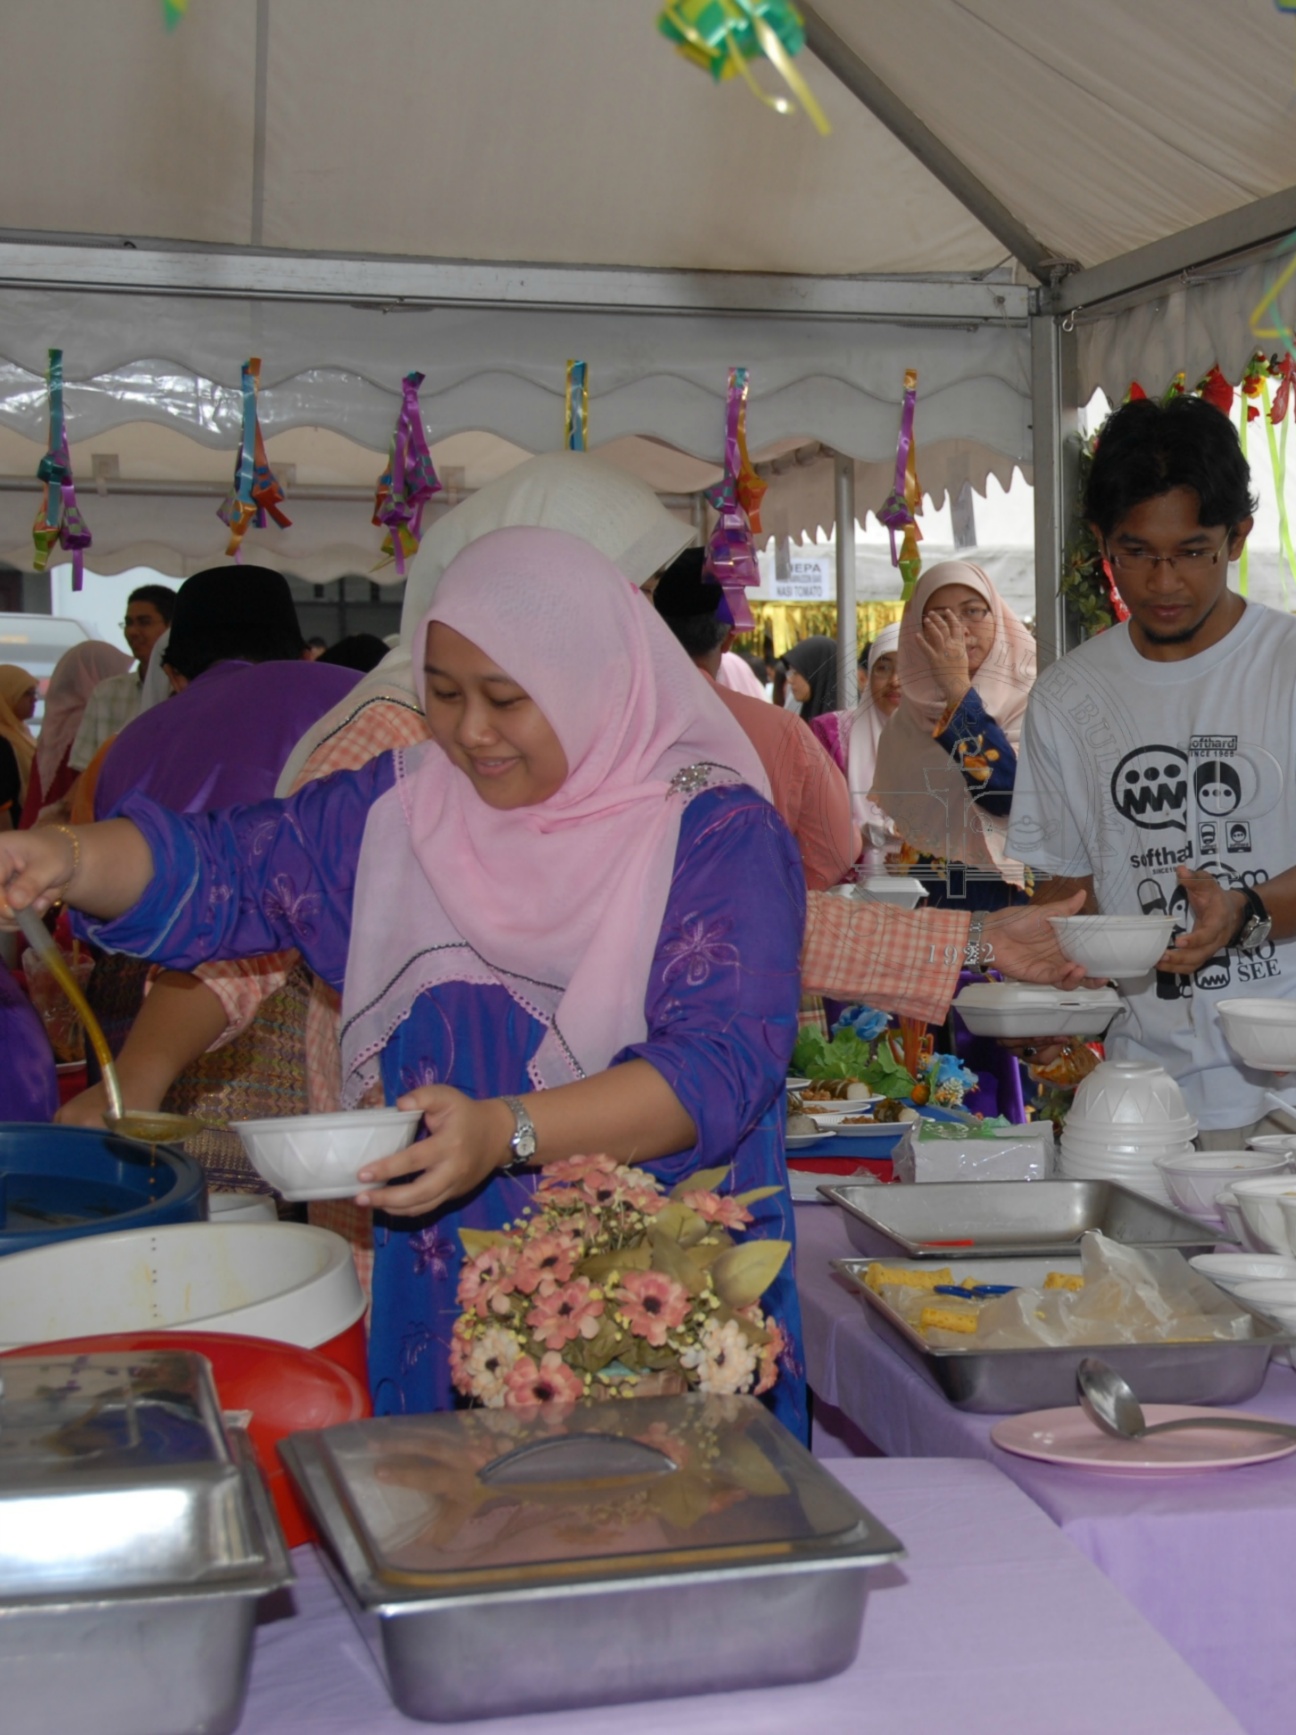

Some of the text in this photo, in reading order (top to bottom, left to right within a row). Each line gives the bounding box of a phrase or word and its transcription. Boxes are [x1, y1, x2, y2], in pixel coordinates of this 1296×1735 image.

[788, 564, 821, 573] EPA
[794, 586, 822, 597] TOMATO
[1190, 738, 1235, 748] ofthard
[1237, 959, 1281, 982] SEE
